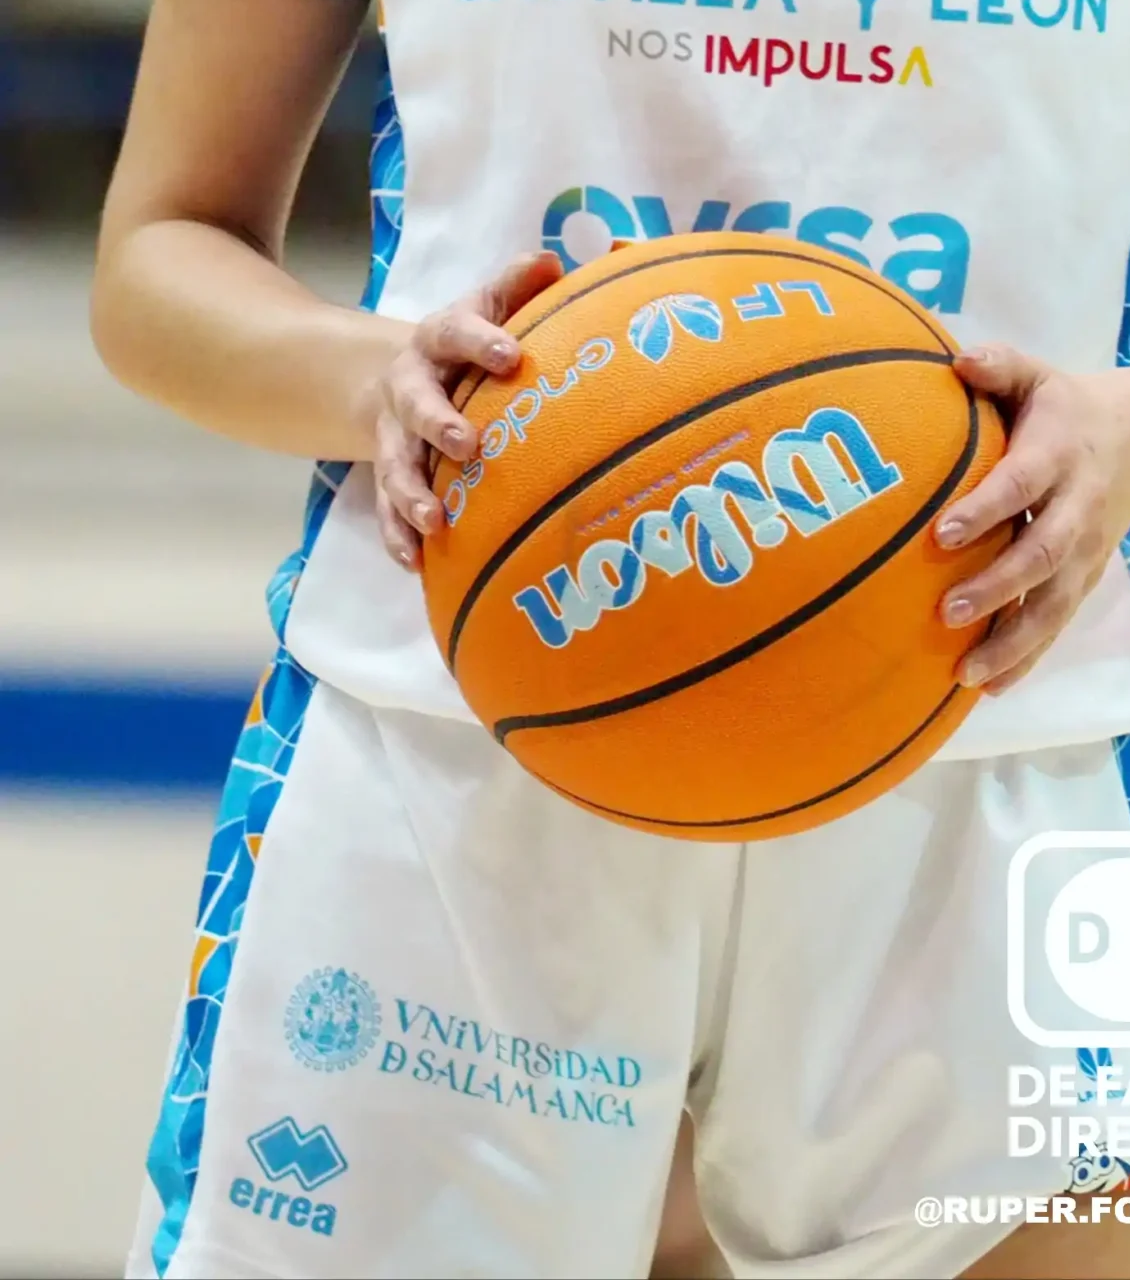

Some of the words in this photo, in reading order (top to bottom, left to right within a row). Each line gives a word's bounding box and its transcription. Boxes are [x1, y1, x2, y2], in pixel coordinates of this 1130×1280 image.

[607, 29, 693, 62] NOS
[704, 35, 934, 88] IMPULSA
[731, 279, 836, 323] LF
[513, 406, 904, 649] Wilson
[412, 1048, 637, 1128] SALAMANCA
[229, 1176, 339, 1237] errea
